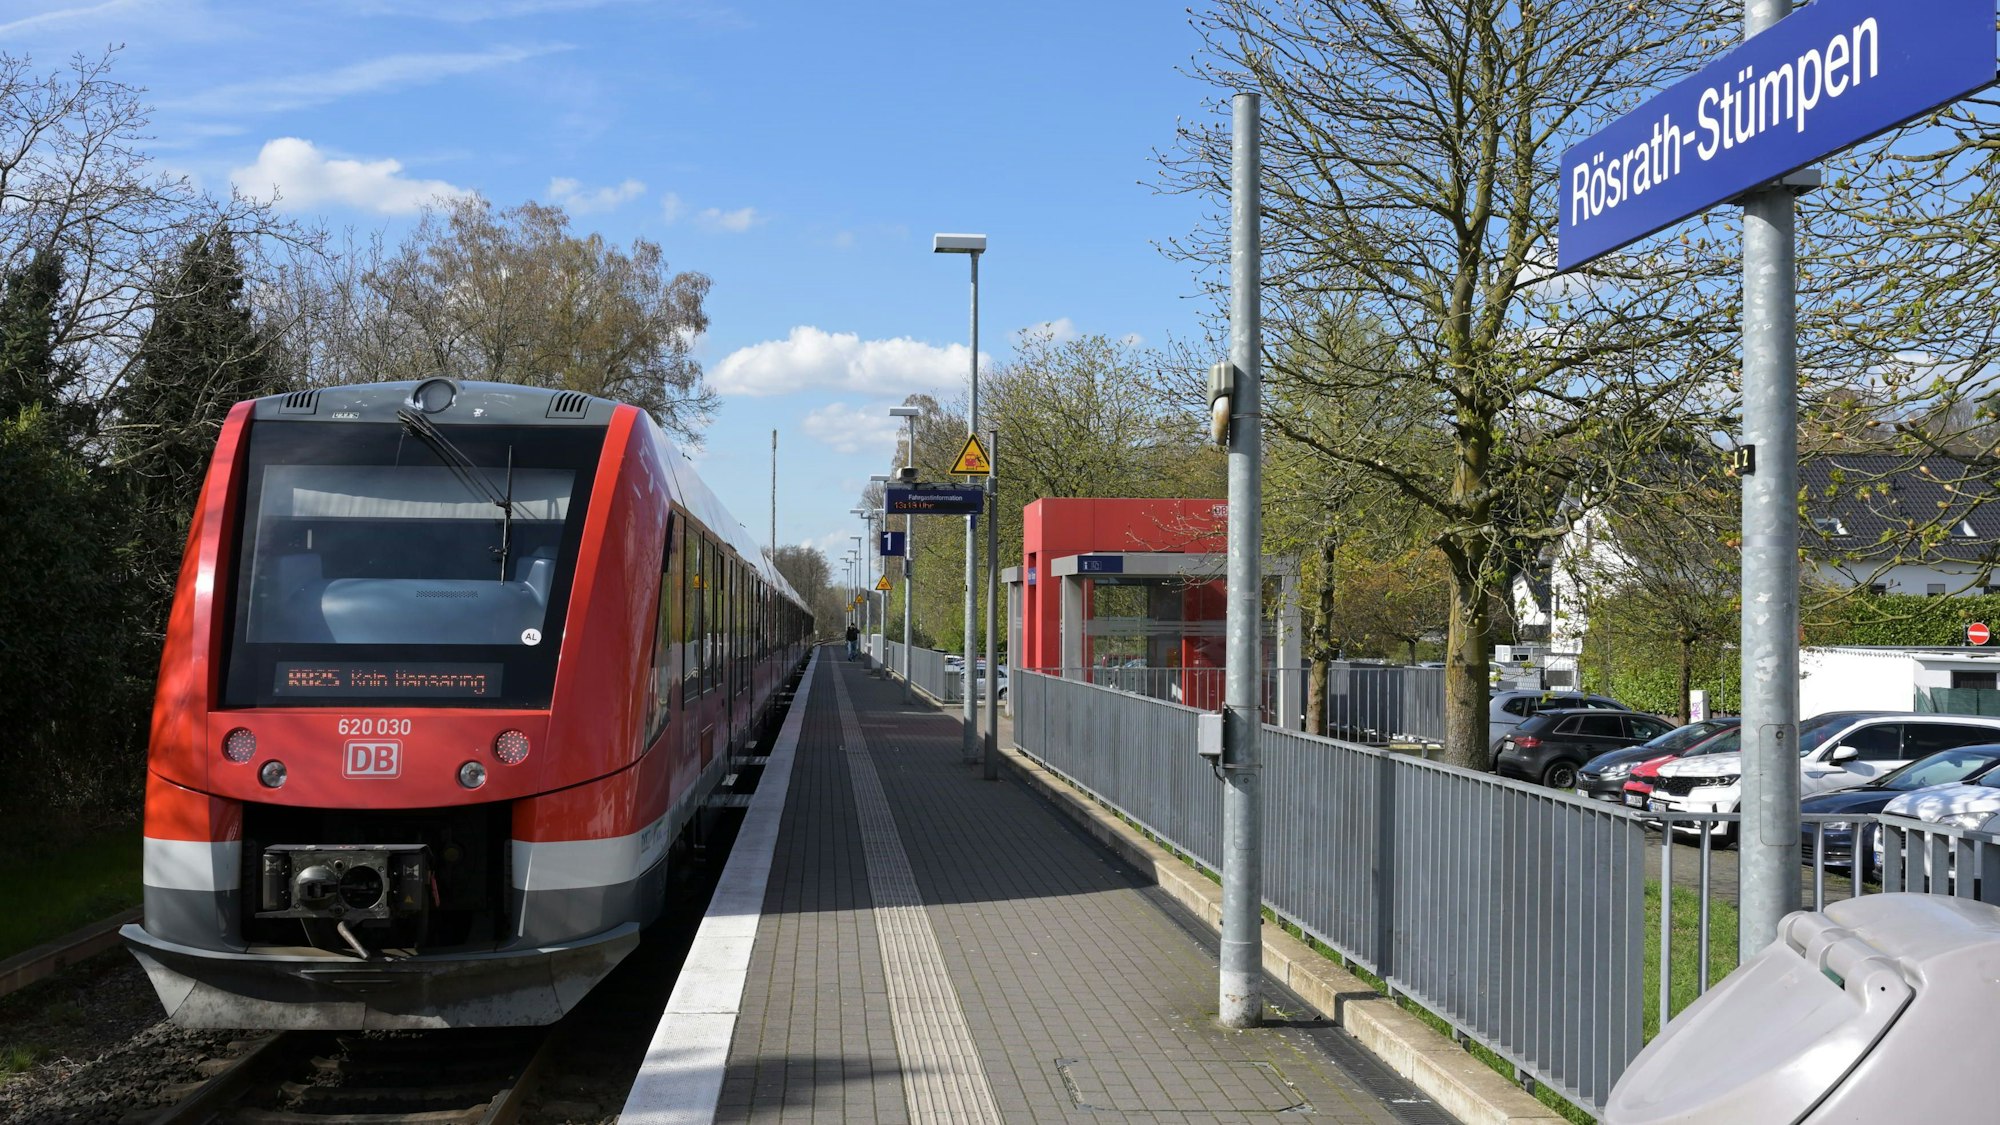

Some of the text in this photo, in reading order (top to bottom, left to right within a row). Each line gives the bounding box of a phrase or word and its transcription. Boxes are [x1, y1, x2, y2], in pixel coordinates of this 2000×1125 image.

[1571, 16, 1879, 227] Rösrath-Stümpen
[919, 501, 935, 509] Uhr
[883, 532, 892, 551] 1
[525, 632, 537, 641] AL
[288, 669, 341, 687] RB25
[338, 718, 412, 735] 620 030
[351, 746, 394, 771] DB
